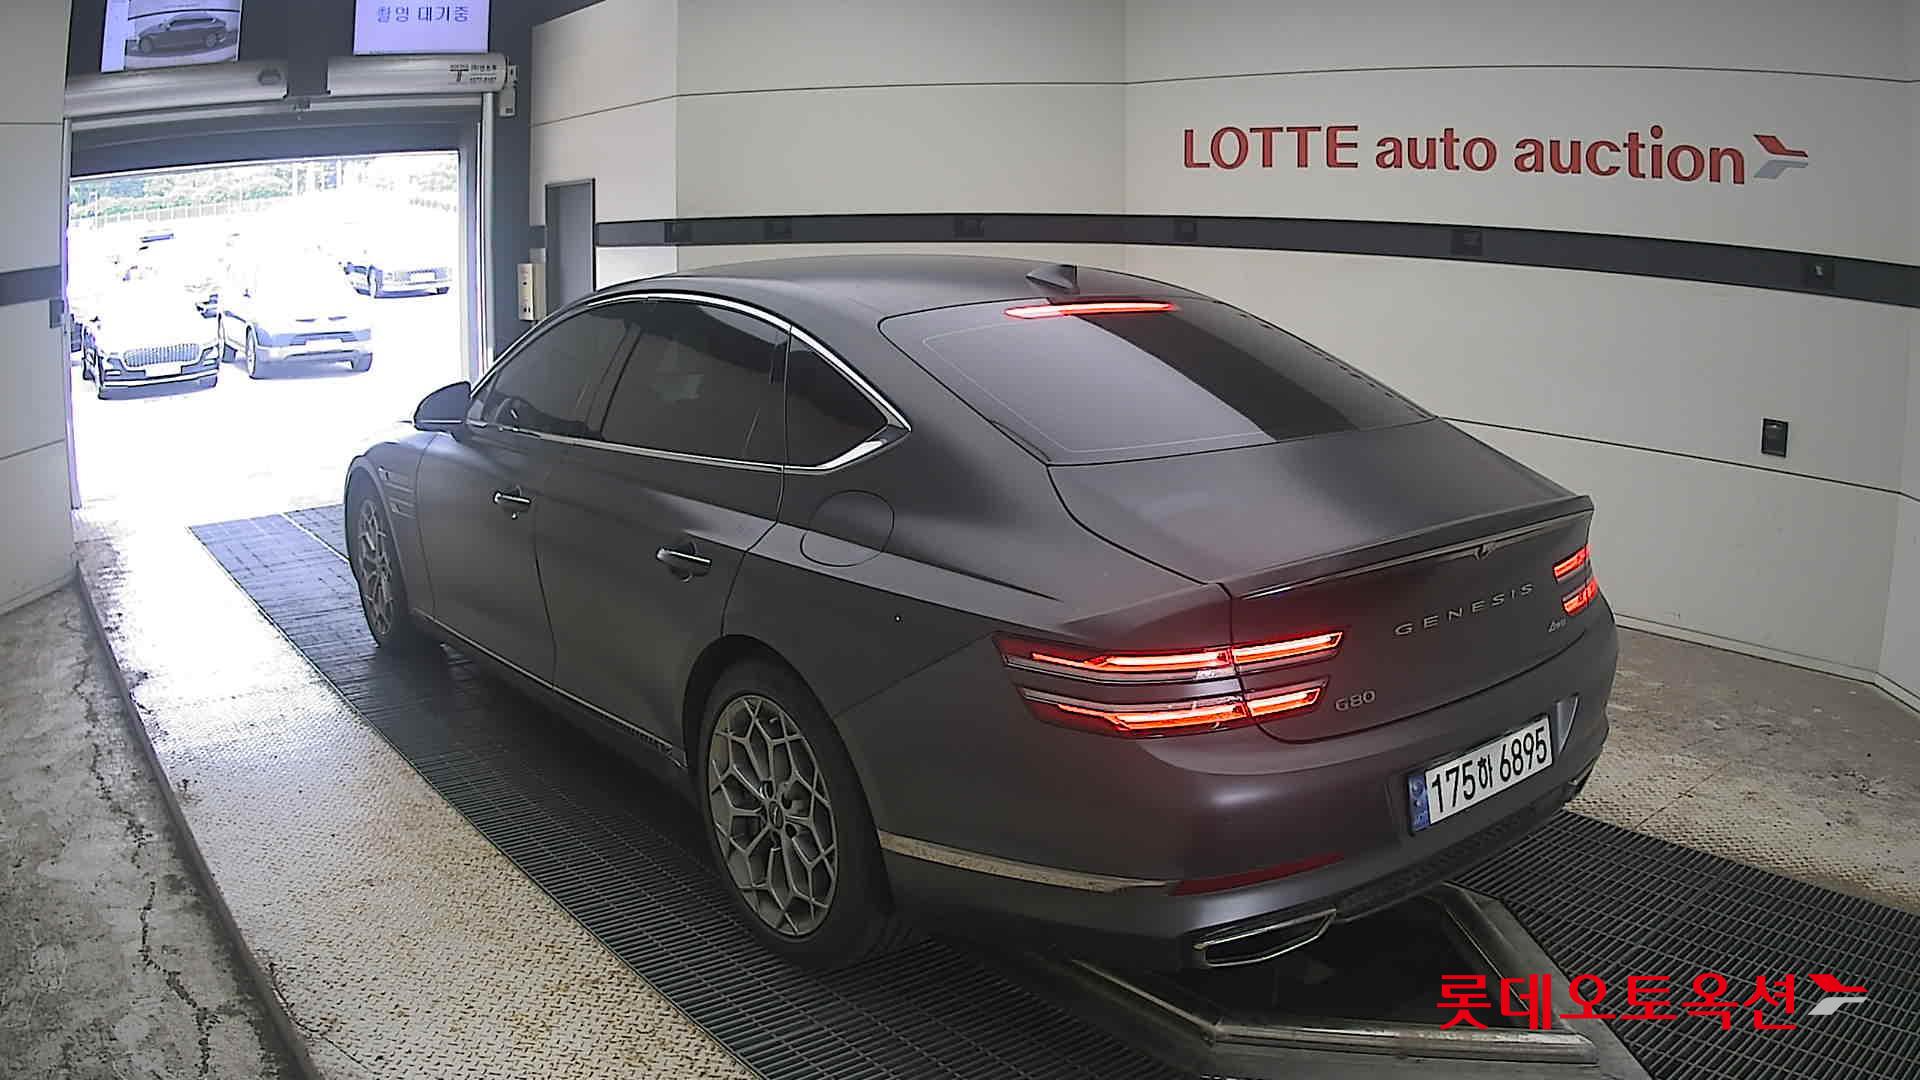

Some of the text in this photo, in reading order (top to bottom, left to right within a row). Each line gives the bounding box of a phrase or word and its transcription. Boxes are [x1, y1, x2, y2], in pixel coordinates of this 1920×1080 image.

[418, 6, 470, 23] 대기중
[1184, 124, 1746, 185] LOTTE auto auction
[1394, 583, 1534, 637] GENESIS
[1335, 690, 1376, 711] G80
[1431, 726, 1547, 813] 175하 6895
